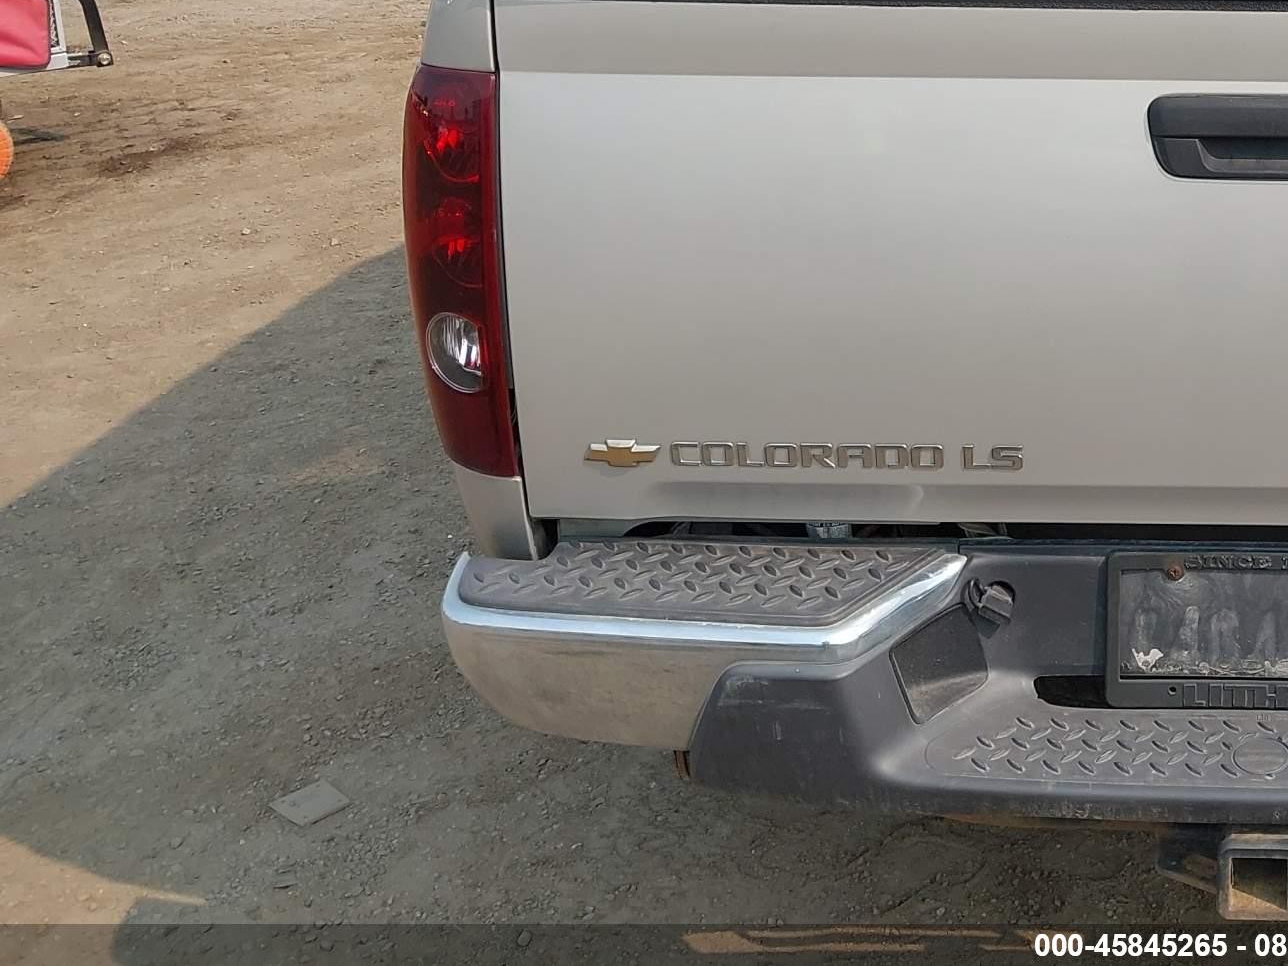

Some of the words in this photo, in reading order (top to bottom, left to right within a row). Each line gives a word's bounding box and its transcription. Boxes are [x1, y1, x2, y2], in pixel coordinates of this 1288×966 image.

[670, 440, 944, 471] COLORADO
[961, 443, 1024, 471] LS
[1184, 554, 1272, 570] SINCE
